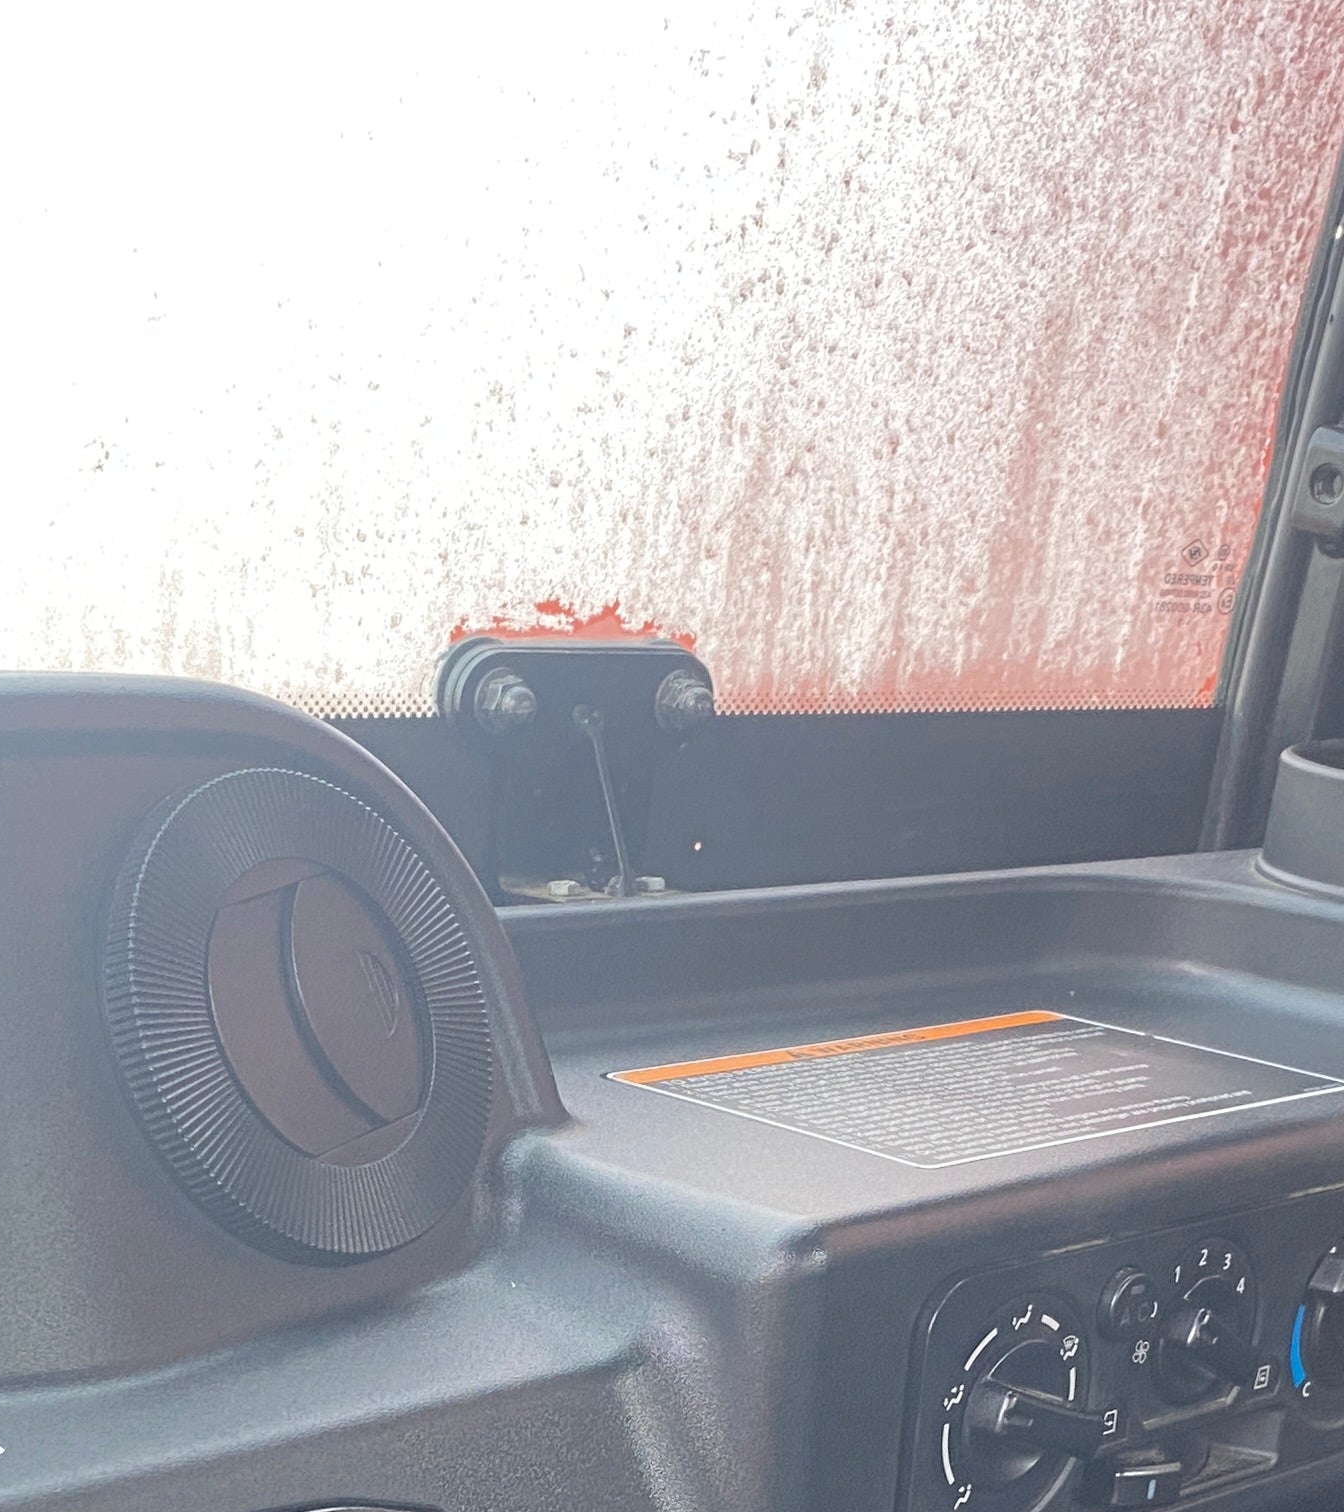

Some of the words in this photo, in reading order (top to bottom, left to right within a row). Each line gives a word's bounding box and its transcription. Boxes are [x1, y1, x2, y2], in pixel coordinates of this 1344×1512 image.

[1173, 1265, 1182, 1283] 1
[1199, 1248, 1208, 1266] 2
[1222, 1252, 1232, 1271] 3
[1236, 1276, 1245, 1295] 4
